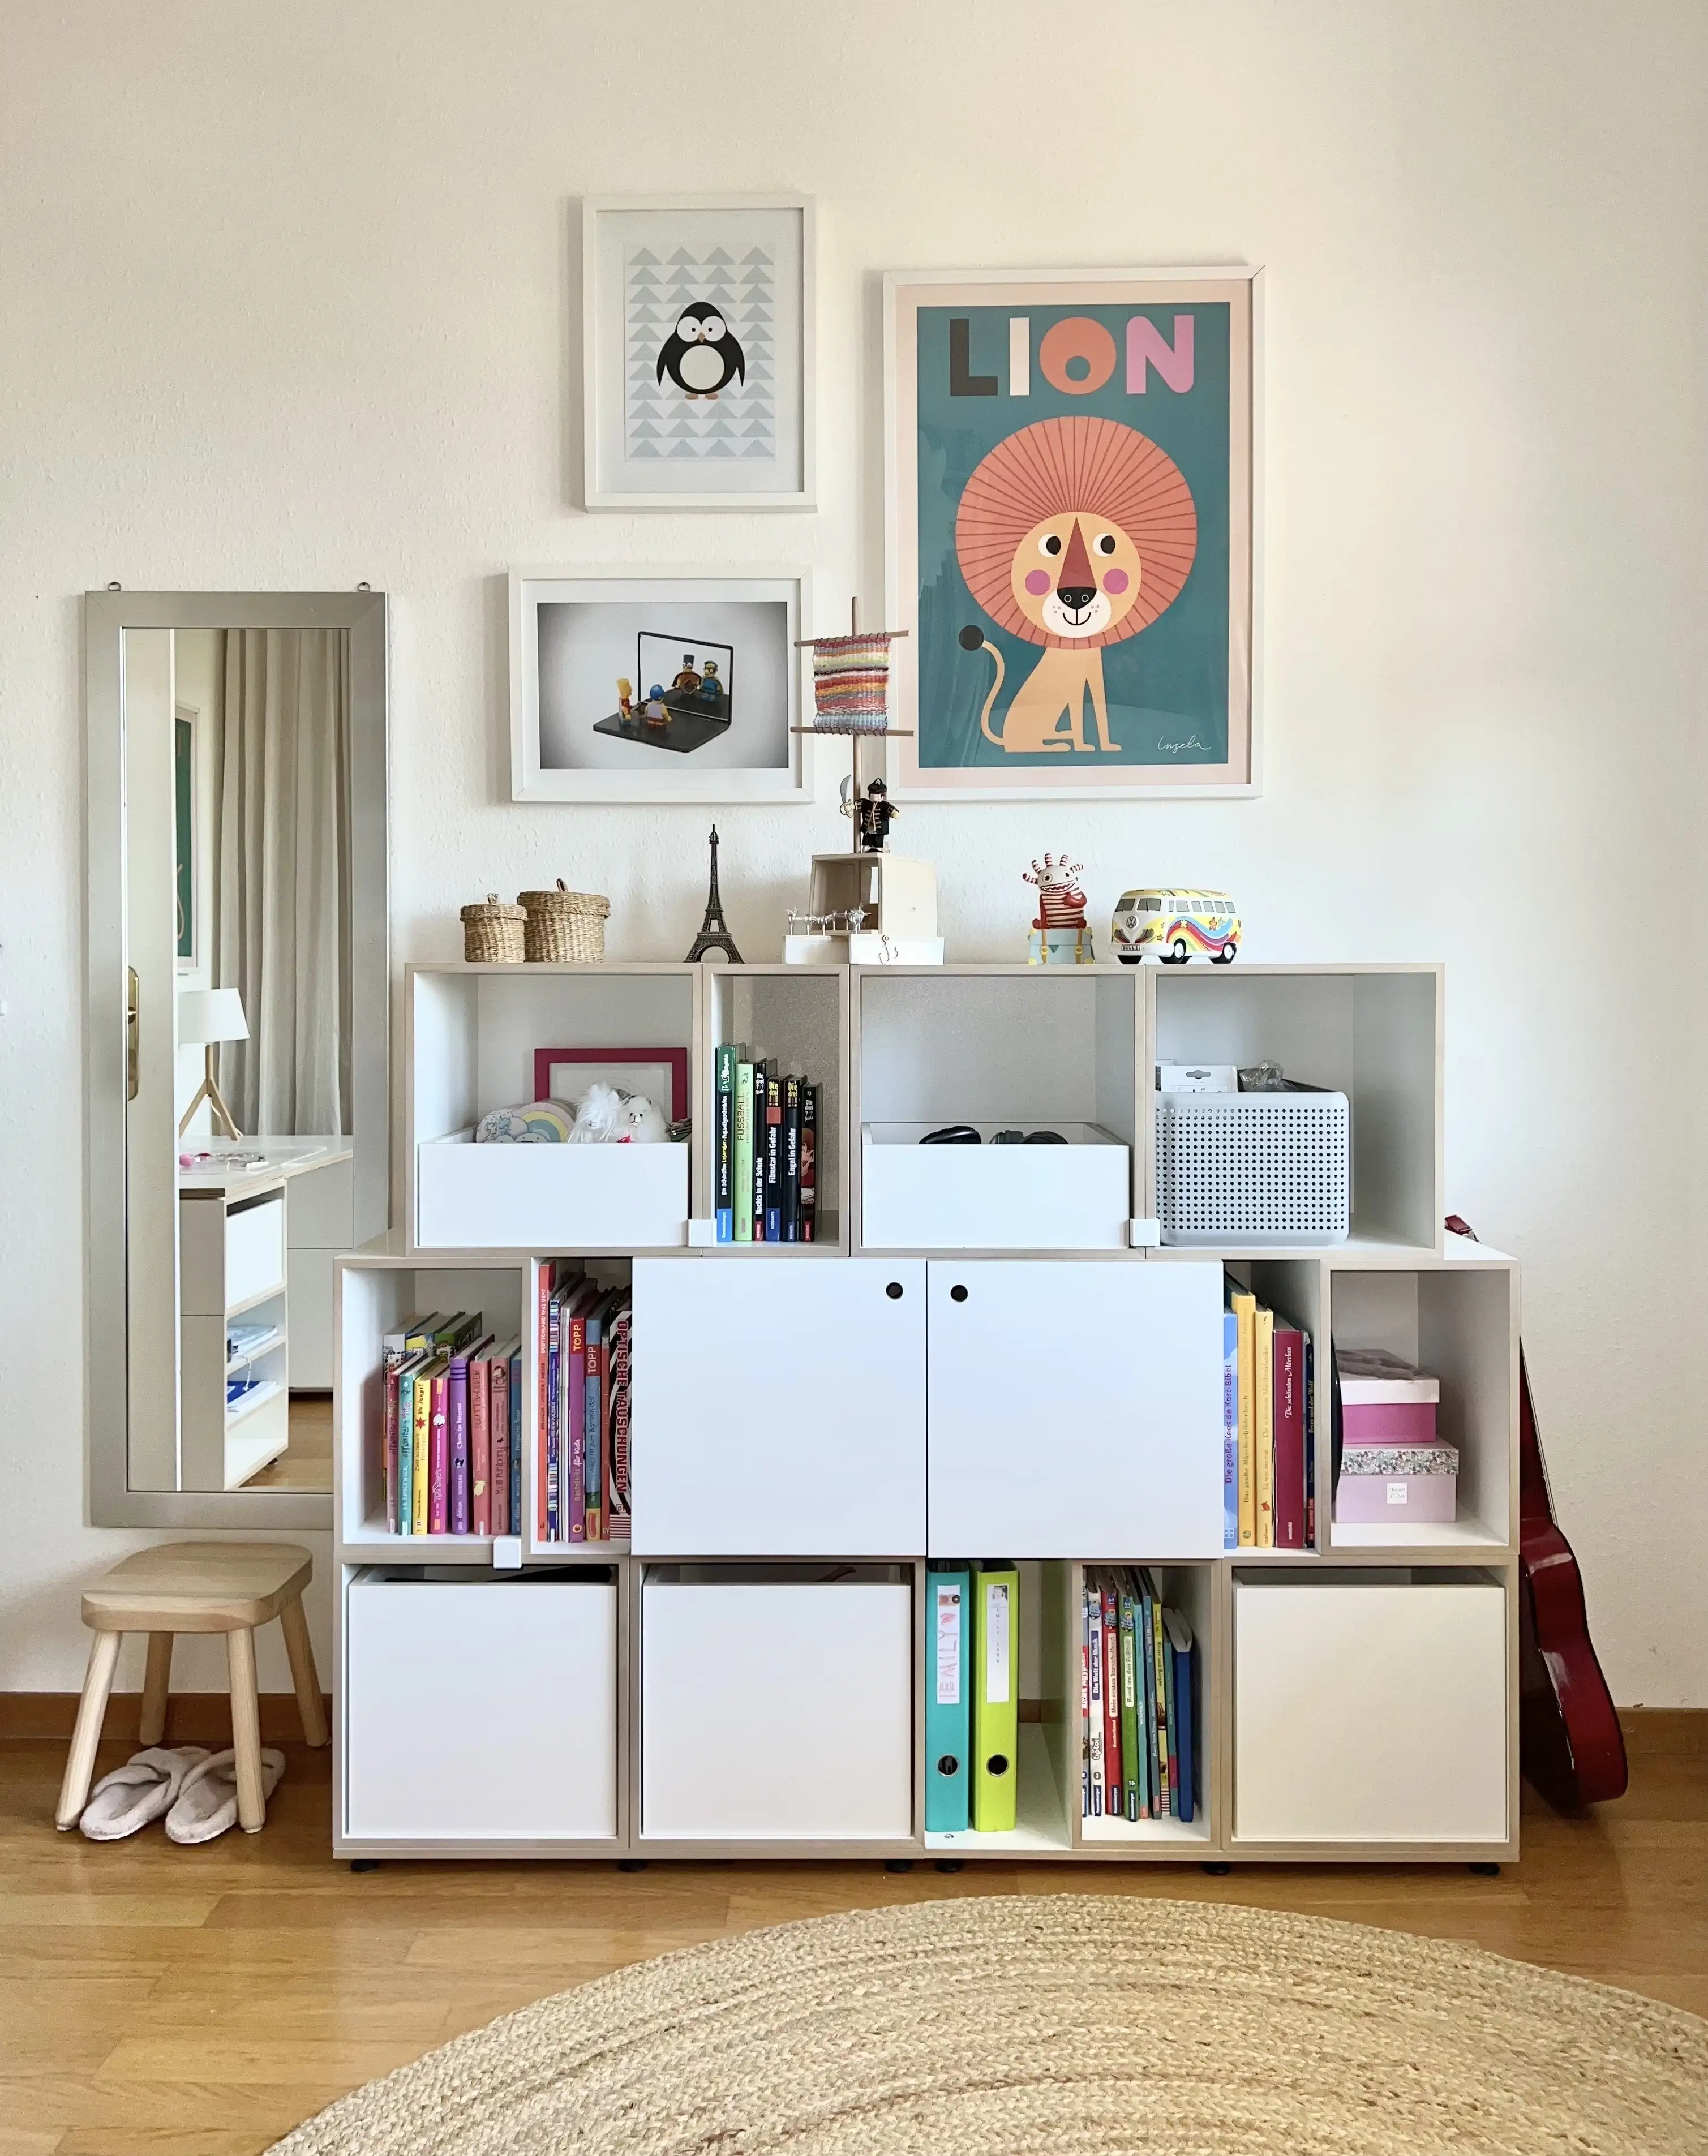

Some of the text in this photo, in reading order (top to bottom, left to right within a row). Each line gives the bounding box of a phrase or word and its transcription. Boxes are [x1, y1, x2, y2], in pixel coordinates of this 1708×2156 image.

[950, 315, 1194, 396] LION
[769, 1081, 778, 1090] Die
[788, 1081, 797, 1090] Die
[588, 1346, 596, 1374] TOPP
[616, 1320, 628, 1386] OPTISCHE
[1225, 1409, 1232, 1419] de
[616, 1390, 630, 1494] TÄUSCHUNGEN
[573, 1455, 582, 1467] für
[1225, 1443, 1234, 1467] große
[938, 1630, 958, 1692] EMILY
[1127, 1676, 1131, 1686] um
